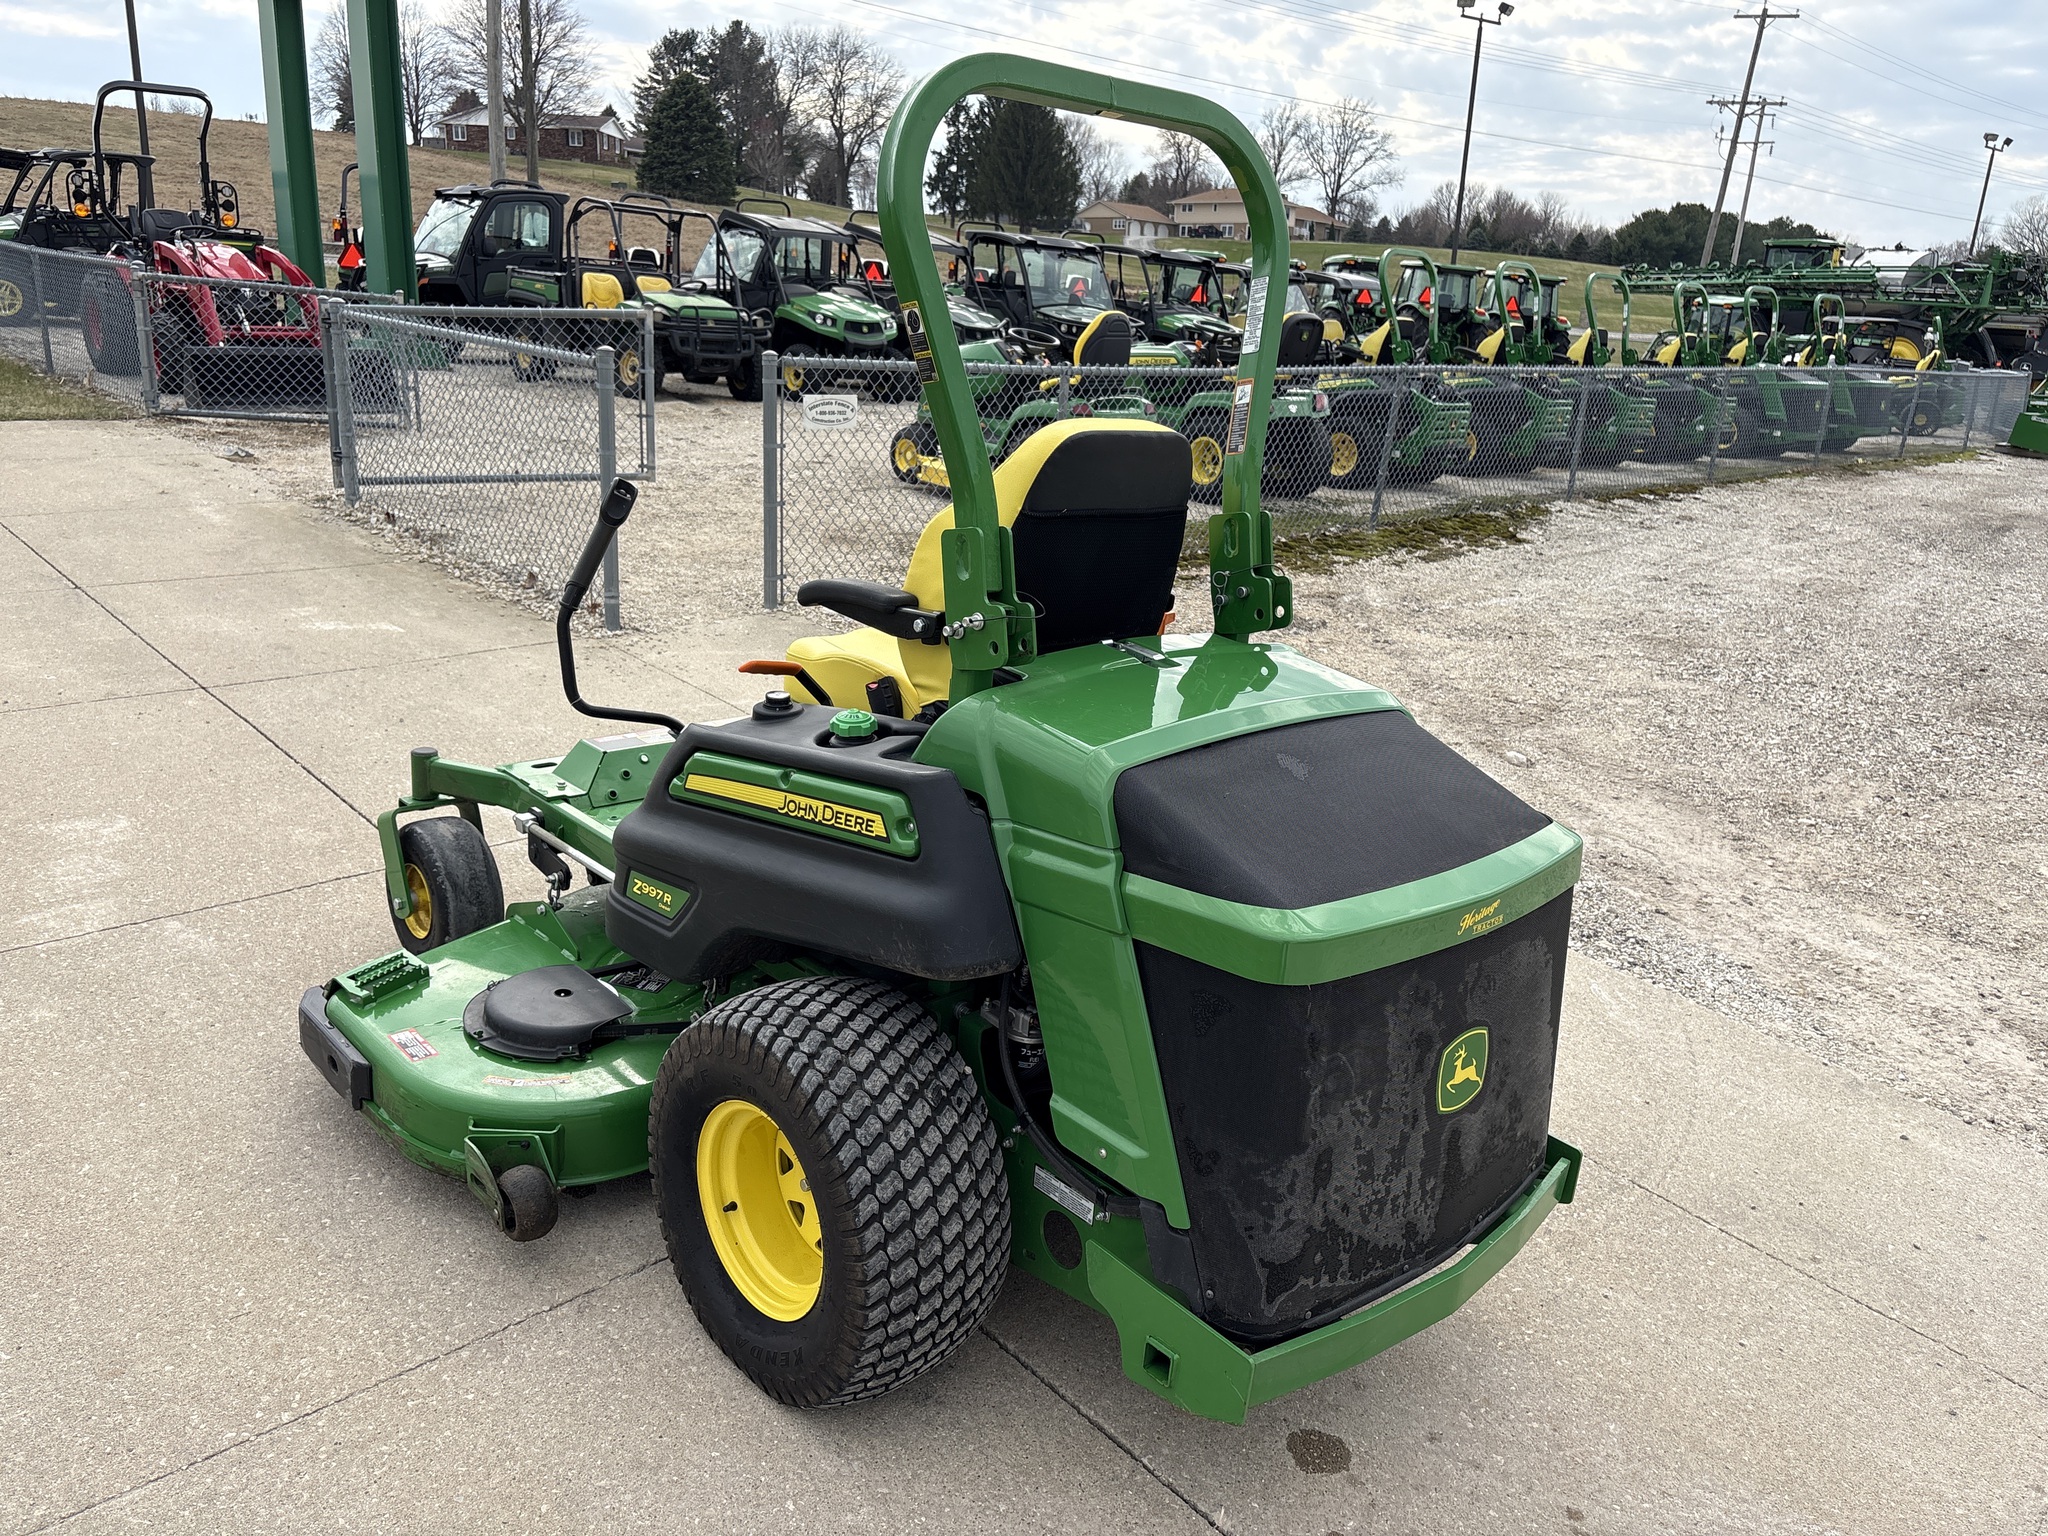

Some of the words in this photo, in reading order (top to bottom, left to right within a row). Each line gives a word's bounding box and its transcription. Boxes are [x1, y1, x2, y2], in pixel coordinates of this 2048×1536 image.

[808, 401, 833, 412] Interstate
[834, 400, 851, 410] Fence
[778, 795, 819, 820] JOHN
[821, 804, 876, 834] DEERE
[632, 878, 672, 906] Z997R
[1457, 899, 1501, 936] Heritage
[1472, 914, 1504, 935] TRACTOR
[735, 1332, 804, 1368] KENDA
